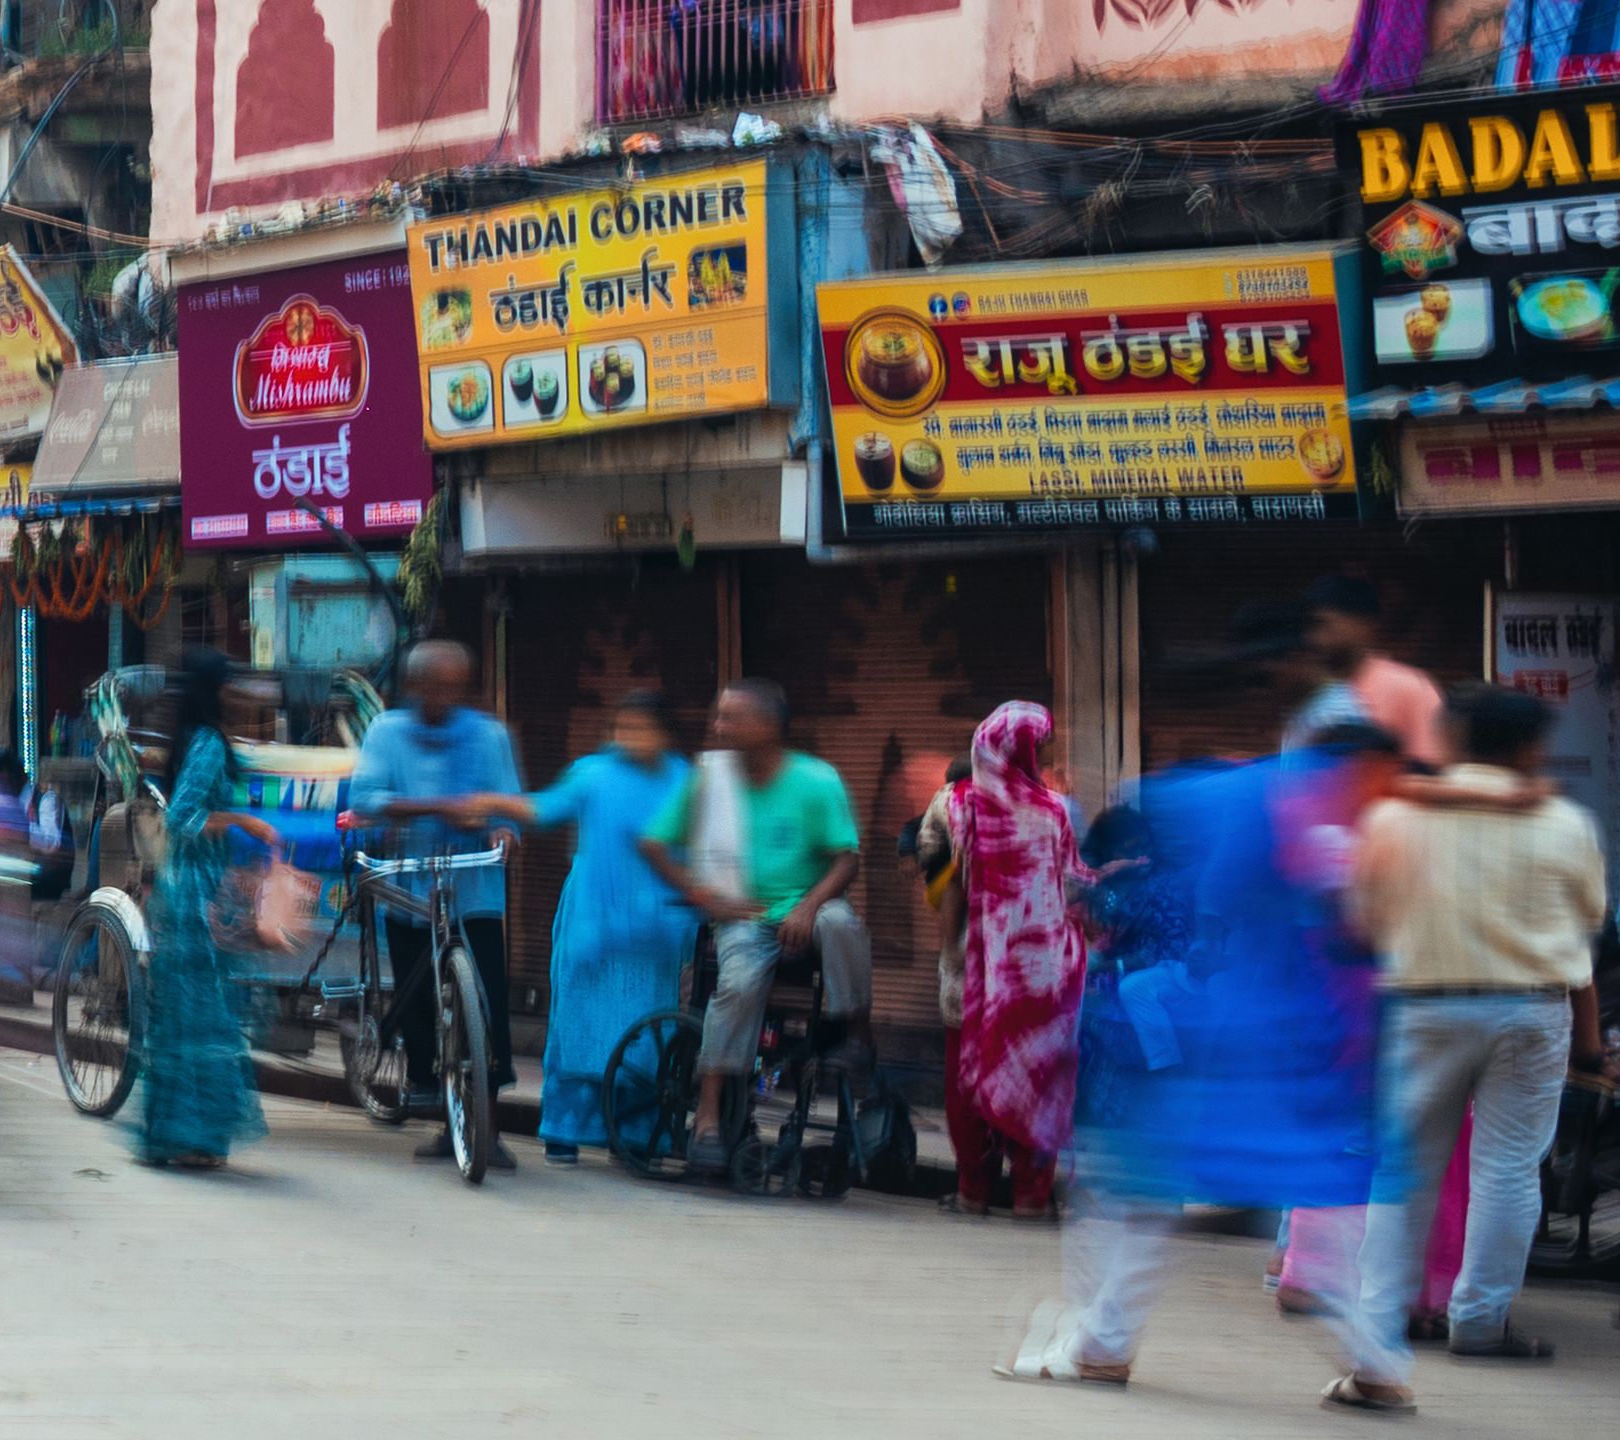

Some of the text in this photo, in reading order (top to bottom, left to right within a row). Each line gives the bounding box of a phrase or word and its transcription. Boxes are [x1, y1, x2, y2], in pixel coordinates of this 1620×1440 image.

[1358, 103, 1620, 203] BADAL
[424, 177, 747, 274] THANDAI CORNER
[489, 260, 576, 336] ठंडाई
[1009, 290, 1057, 313] THANDAI
[249, 365, 353, 412] Mishrambu
[961, 313, 1312, 396] राजू ठंडई घर
[252, 422, 351, 500] ठंडाई
[1029, 464, 1245, 496] LASSI, MINERAL WATER
[1250, 489, 1326, 520] वाराणसी
